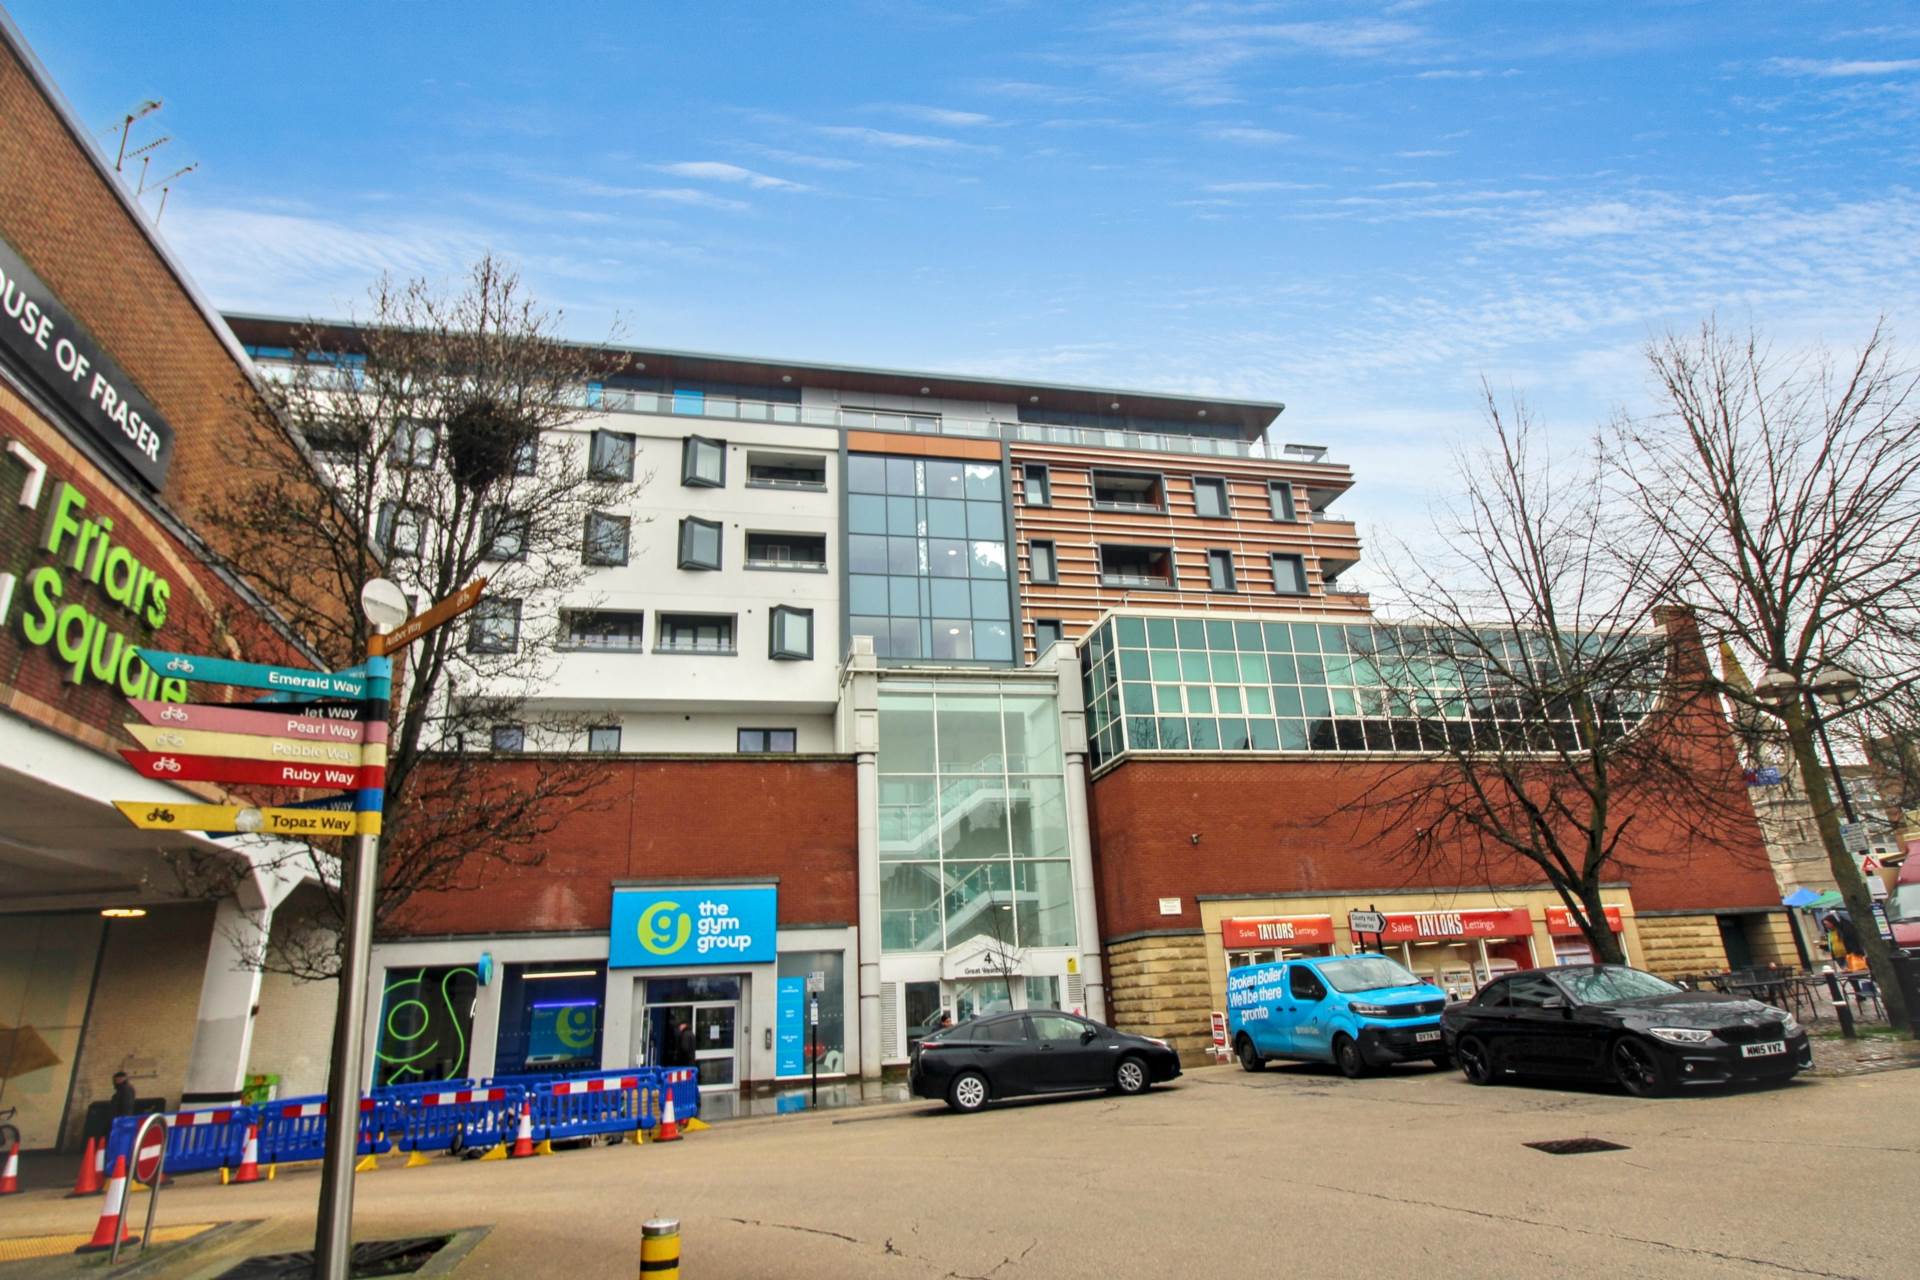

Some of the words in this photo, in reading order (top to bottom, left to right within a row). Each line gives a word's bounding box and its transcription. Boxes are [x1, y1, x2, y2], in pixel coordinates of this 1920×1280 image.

[0, 267, 54, 351] USE
[56, 338, 90, 382] OF
[90, 372, 161, 462] FRASER
[46, 481, 171, 629] Friars
[268, 671, 329, 689] Emerald
[333, 680, 362, 695] Way
[328, 707, 358, 720] Way
[287, 720, 325, 735] Pearl
[329, 724, 358, 740] Way
[282, 767, 320, 783] Ruby
[325, 770, 354, 785] Way
[272, 815, 317, 830] Topaz
[321, 818, 350, 832] Way
[698, 900, 729, 916] the
[697, 917, 740, 935] gym
[1257, 923, 1294, 940] TAYLORS
[1391, 922, 1414, 933] Sales
[1414, 913, 1464, 936] TAYLORS
[1463, 919, 1495, 931] Lettings
[697, 935, 752, 954] group
[983, 951, 991, 964] 4
[1230, 974, 1257, 991] Broken
[1257, 964, 1288, 985] Boiler?
[1247, 989, 1258, 1004] be
[1258, 986, 1282, 1001] there
[1241, 1005, 1269, 1025] pronto
